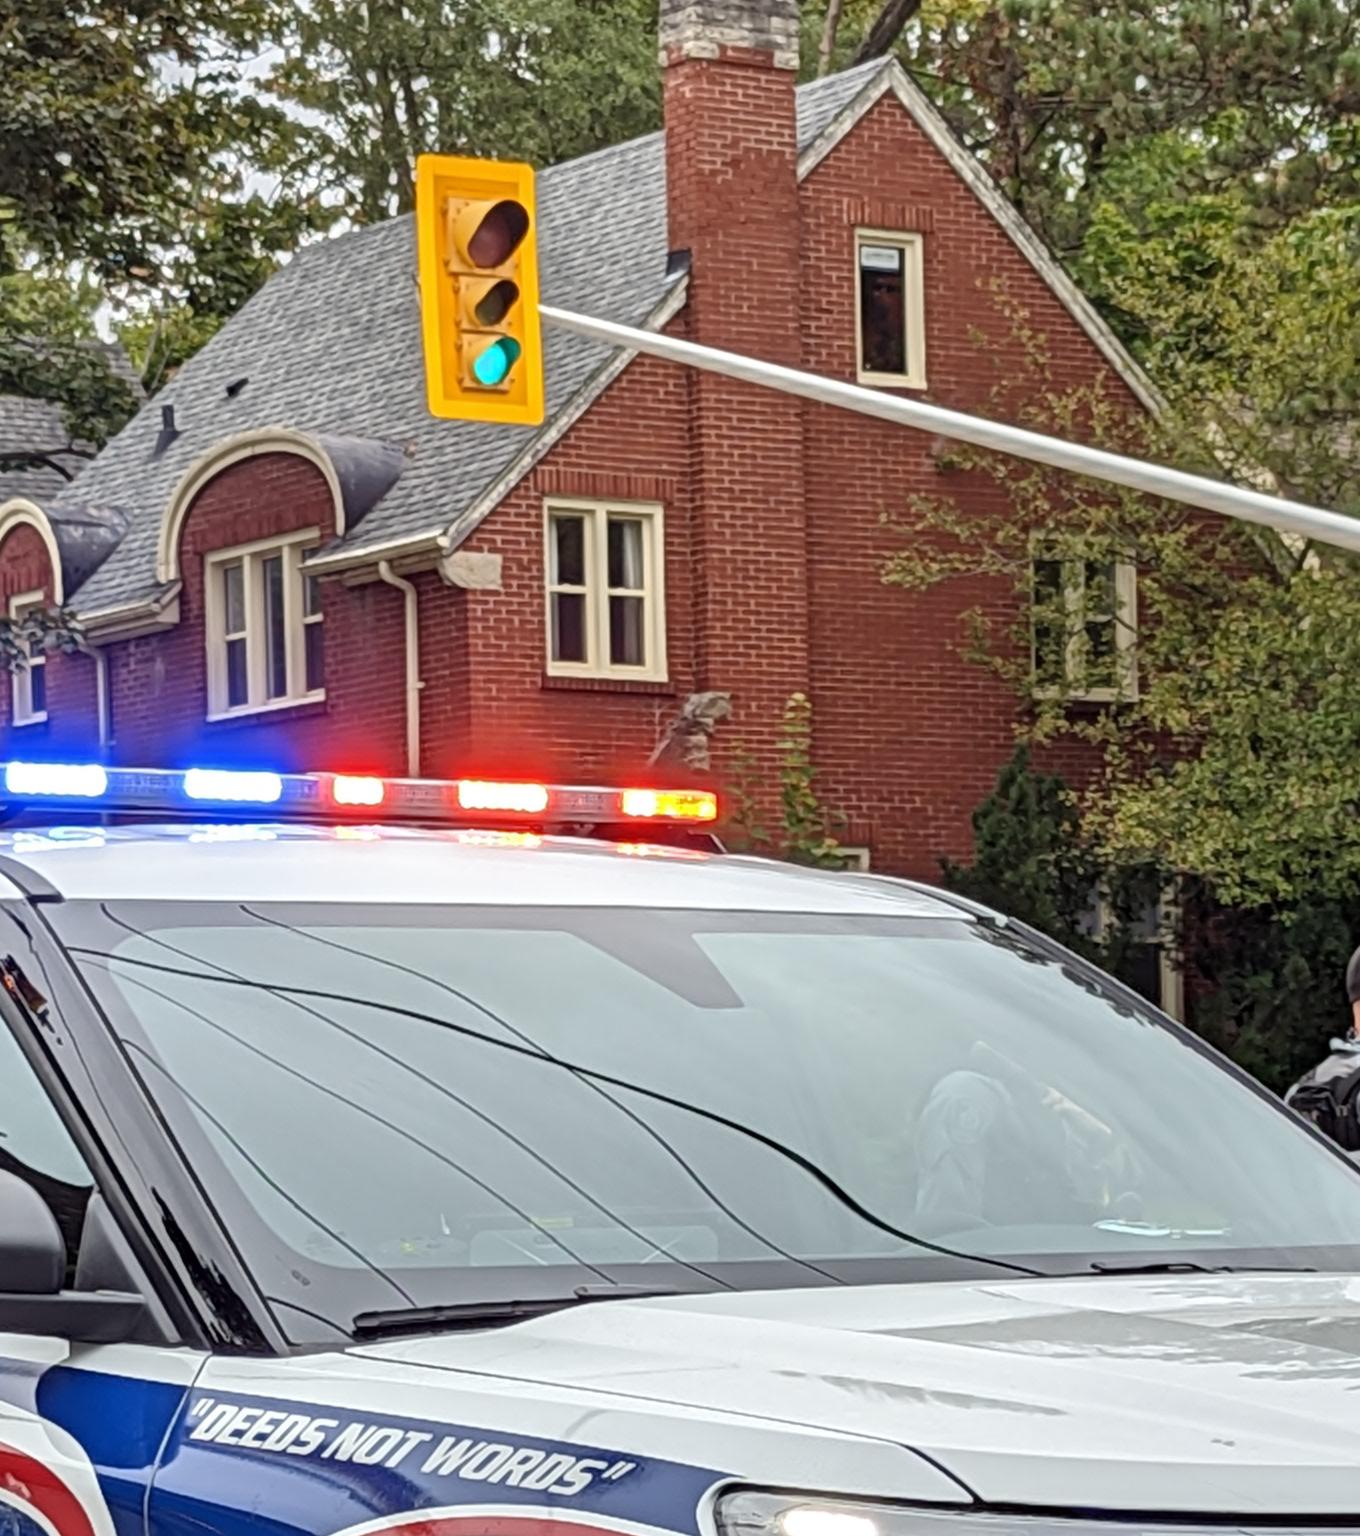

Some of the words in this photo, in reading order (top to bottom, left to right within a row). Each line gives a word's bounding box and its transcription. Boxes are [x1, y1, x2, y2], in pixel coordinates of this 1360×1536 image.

[190, 1398, 339, 1456] "DEEDS
[322, 1422, 434, 1468] NOT
[421, 1436, 637, 1496] WORDS"
